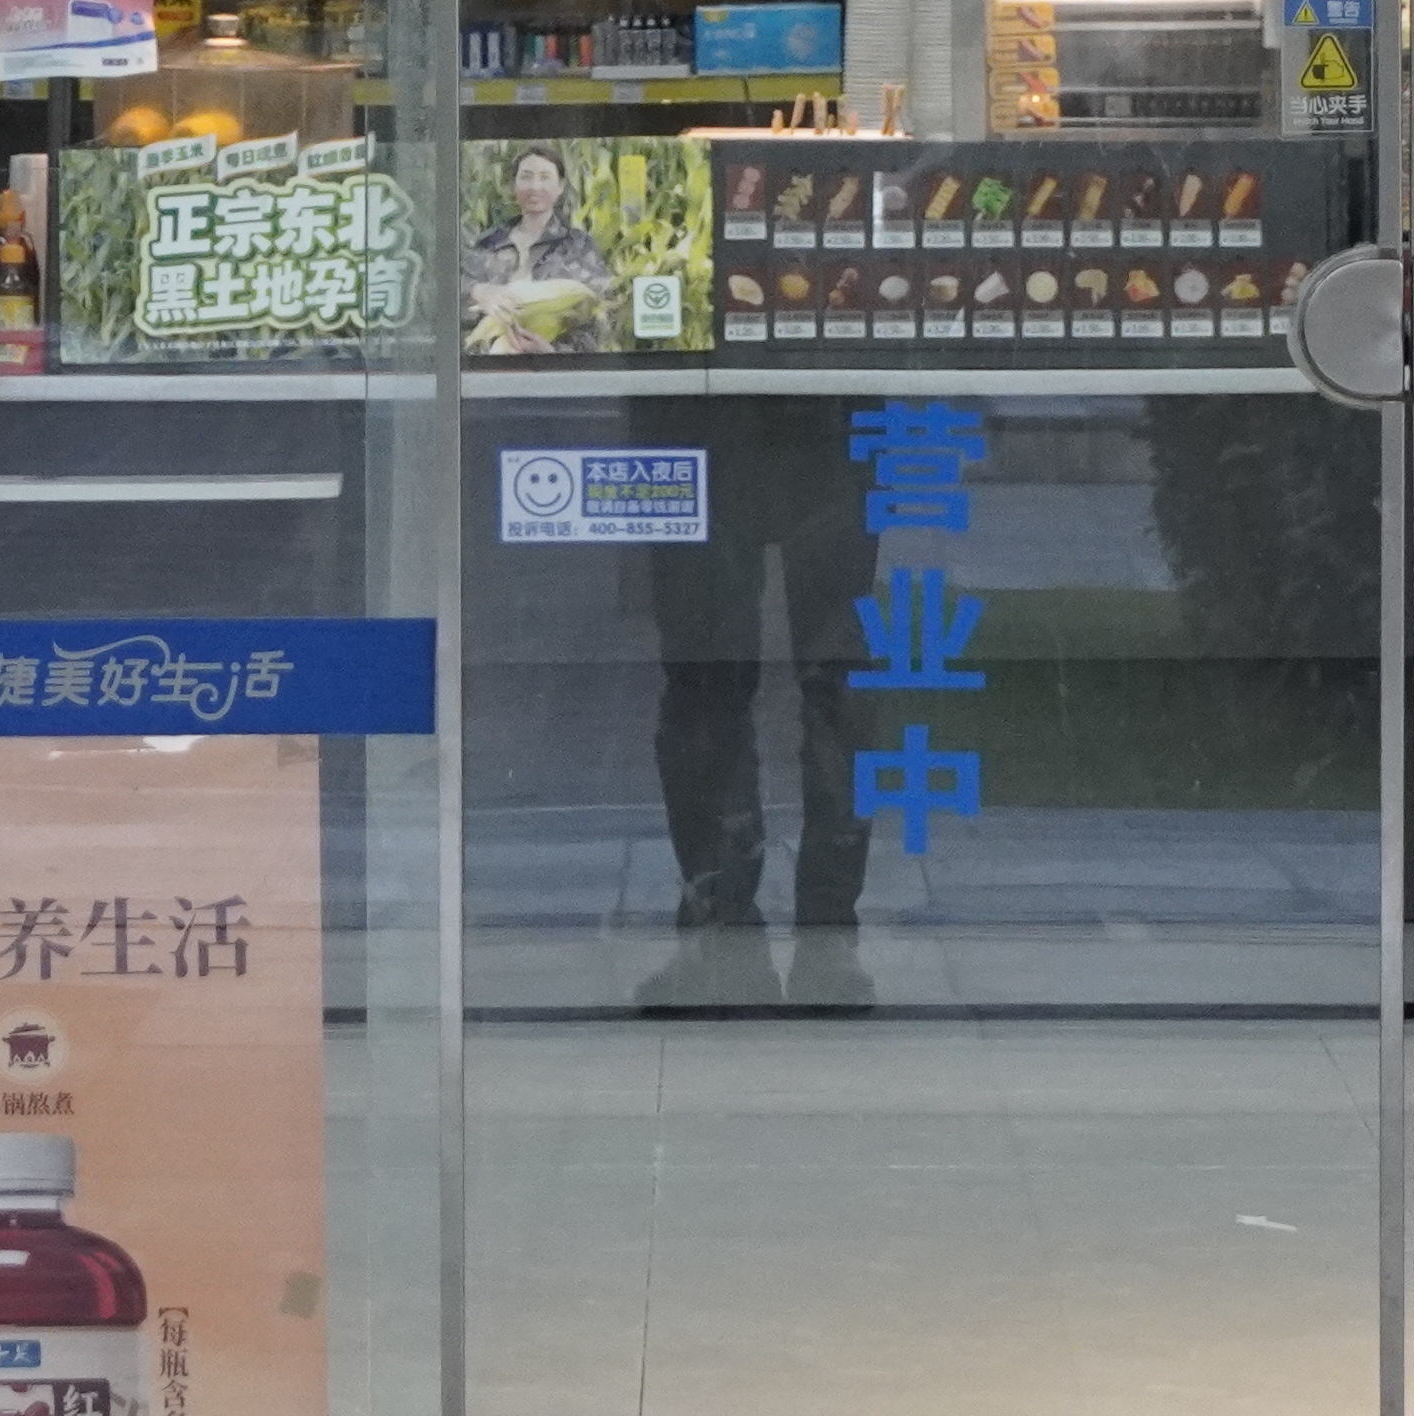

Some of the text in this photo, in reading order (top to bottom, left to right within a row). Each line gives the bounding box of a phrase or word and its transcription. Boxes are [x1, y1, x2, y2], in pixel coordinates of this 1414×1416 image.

[1290, 94, 1367, 116] 当心夹手
[152, 184, 395, 259] 正宗东北
[146, 256, 407, 322] 黑土地孕育
[587, 461, 693, 483] 本店入夜后
[848, 402, 987, 854] 营业中
